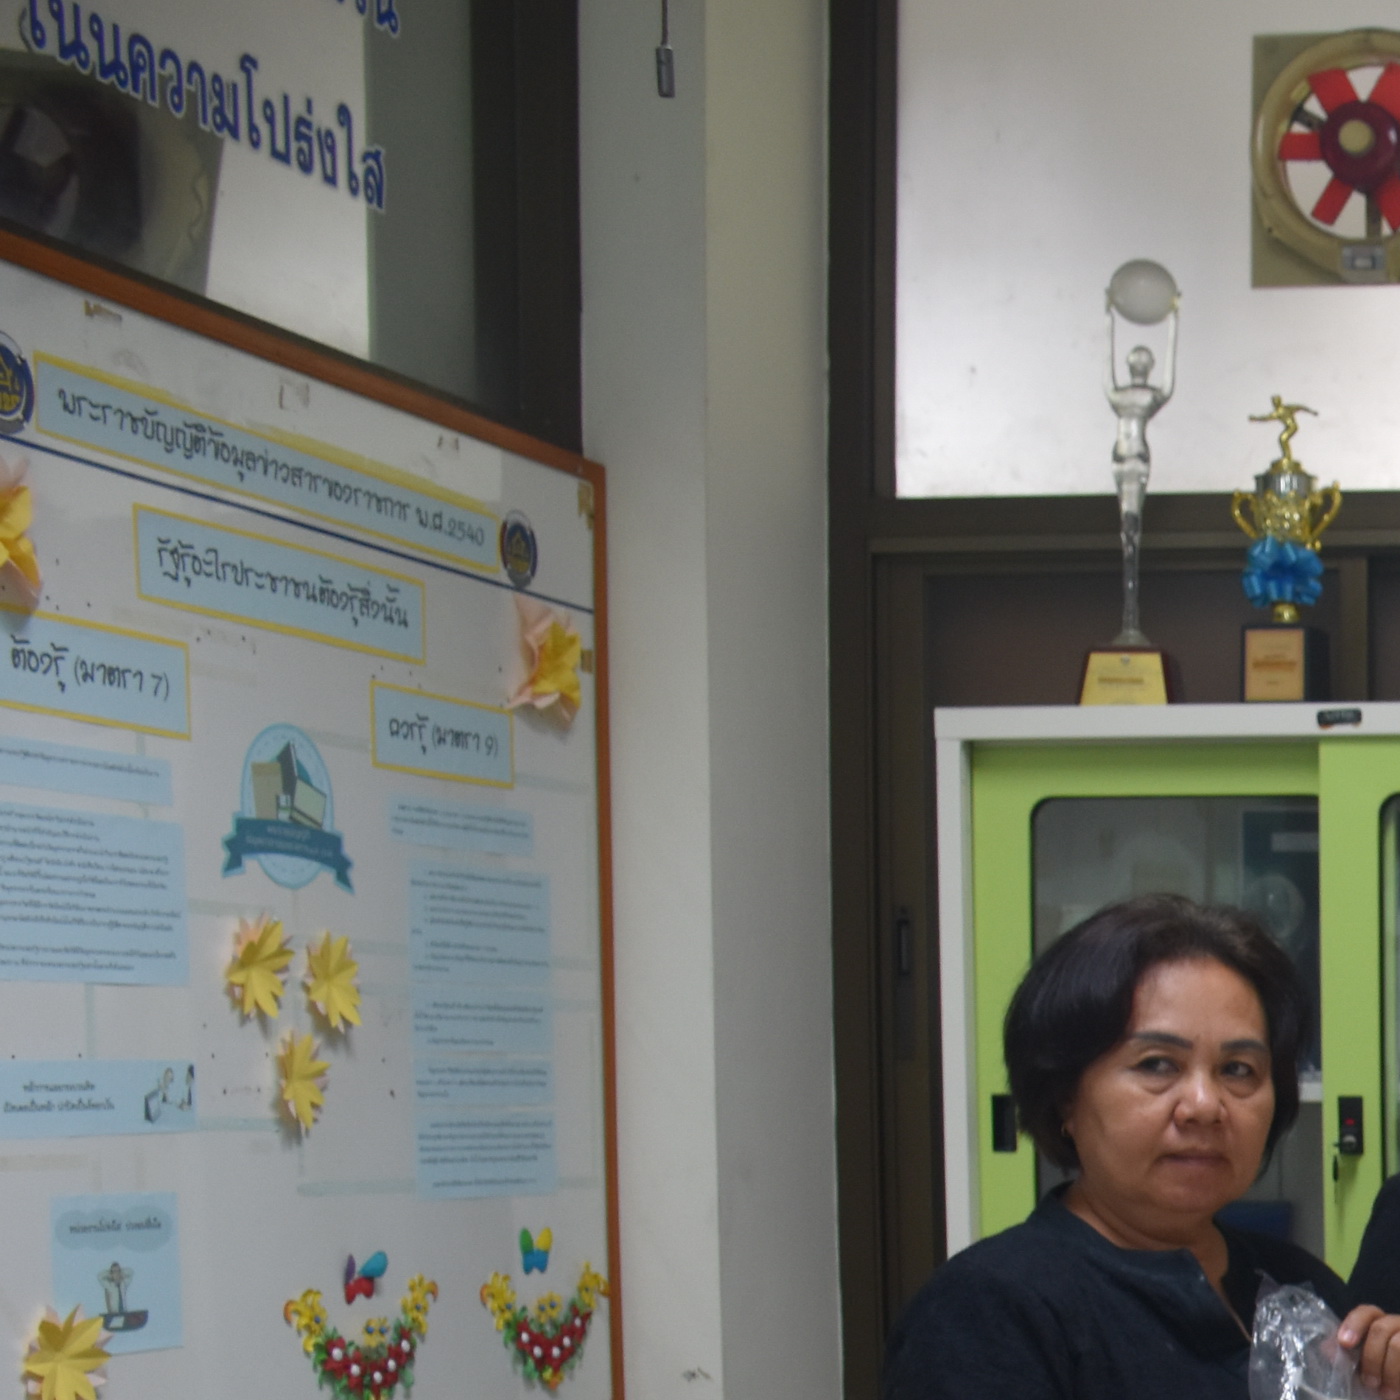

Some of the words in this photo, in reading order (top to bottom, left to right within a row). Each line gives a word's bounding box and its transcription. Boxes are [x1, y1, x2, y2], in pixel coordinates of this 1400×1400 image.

[10, 634, 69, 693] ต้องรู้
[150, 671, 170, 702] 7)
